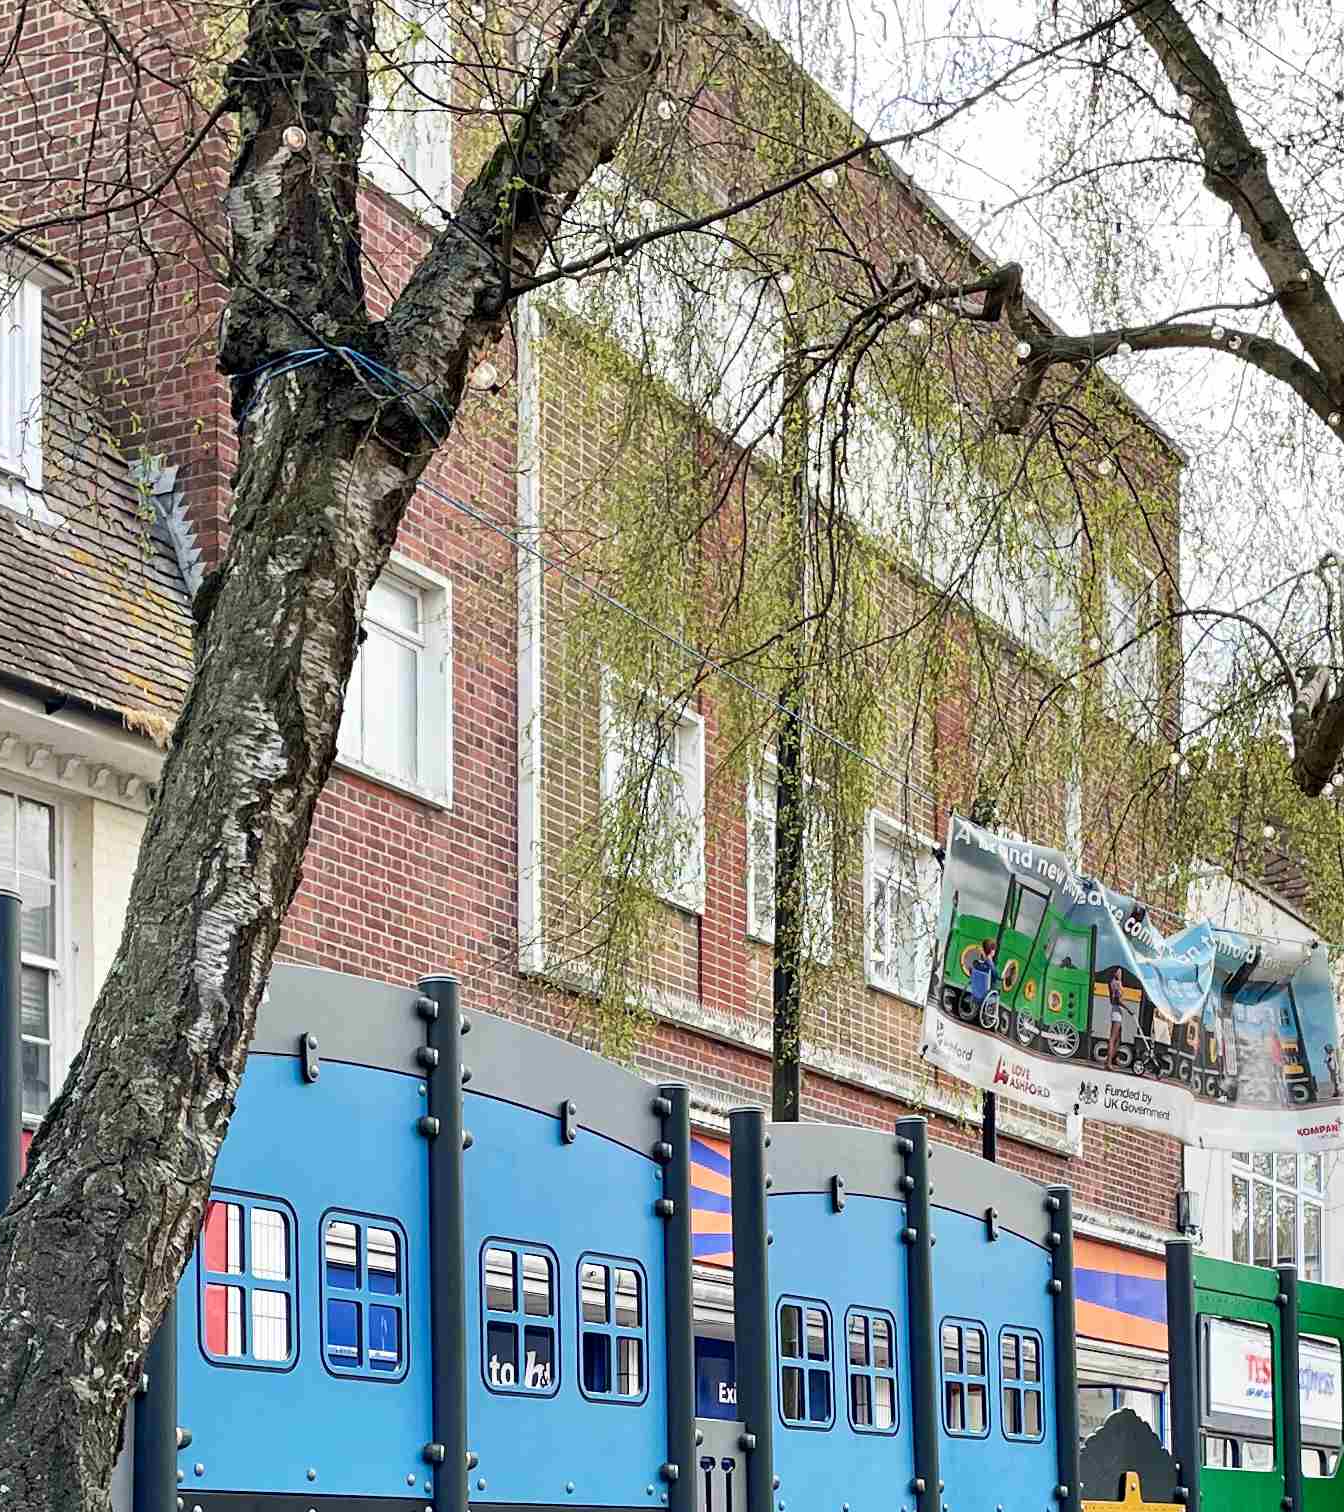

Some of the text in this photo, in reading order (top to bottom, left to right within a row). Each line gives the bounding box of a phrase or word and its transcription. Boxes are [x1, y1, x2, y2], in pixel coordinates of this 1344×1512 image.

[1038, 858, 1066, 885] new
[1011, 1063, 1030, 1079] LOVE
[1009, 1078, 1051, 1099] ASHFORD
[1104, 1083, 1153, 1105] Funded by
[1104, 1096, 1170, 1121] UK Government
[1296, 1123, 1339, 1137] KOMPAN
[1247, 1353, 1272, 1385] TES
